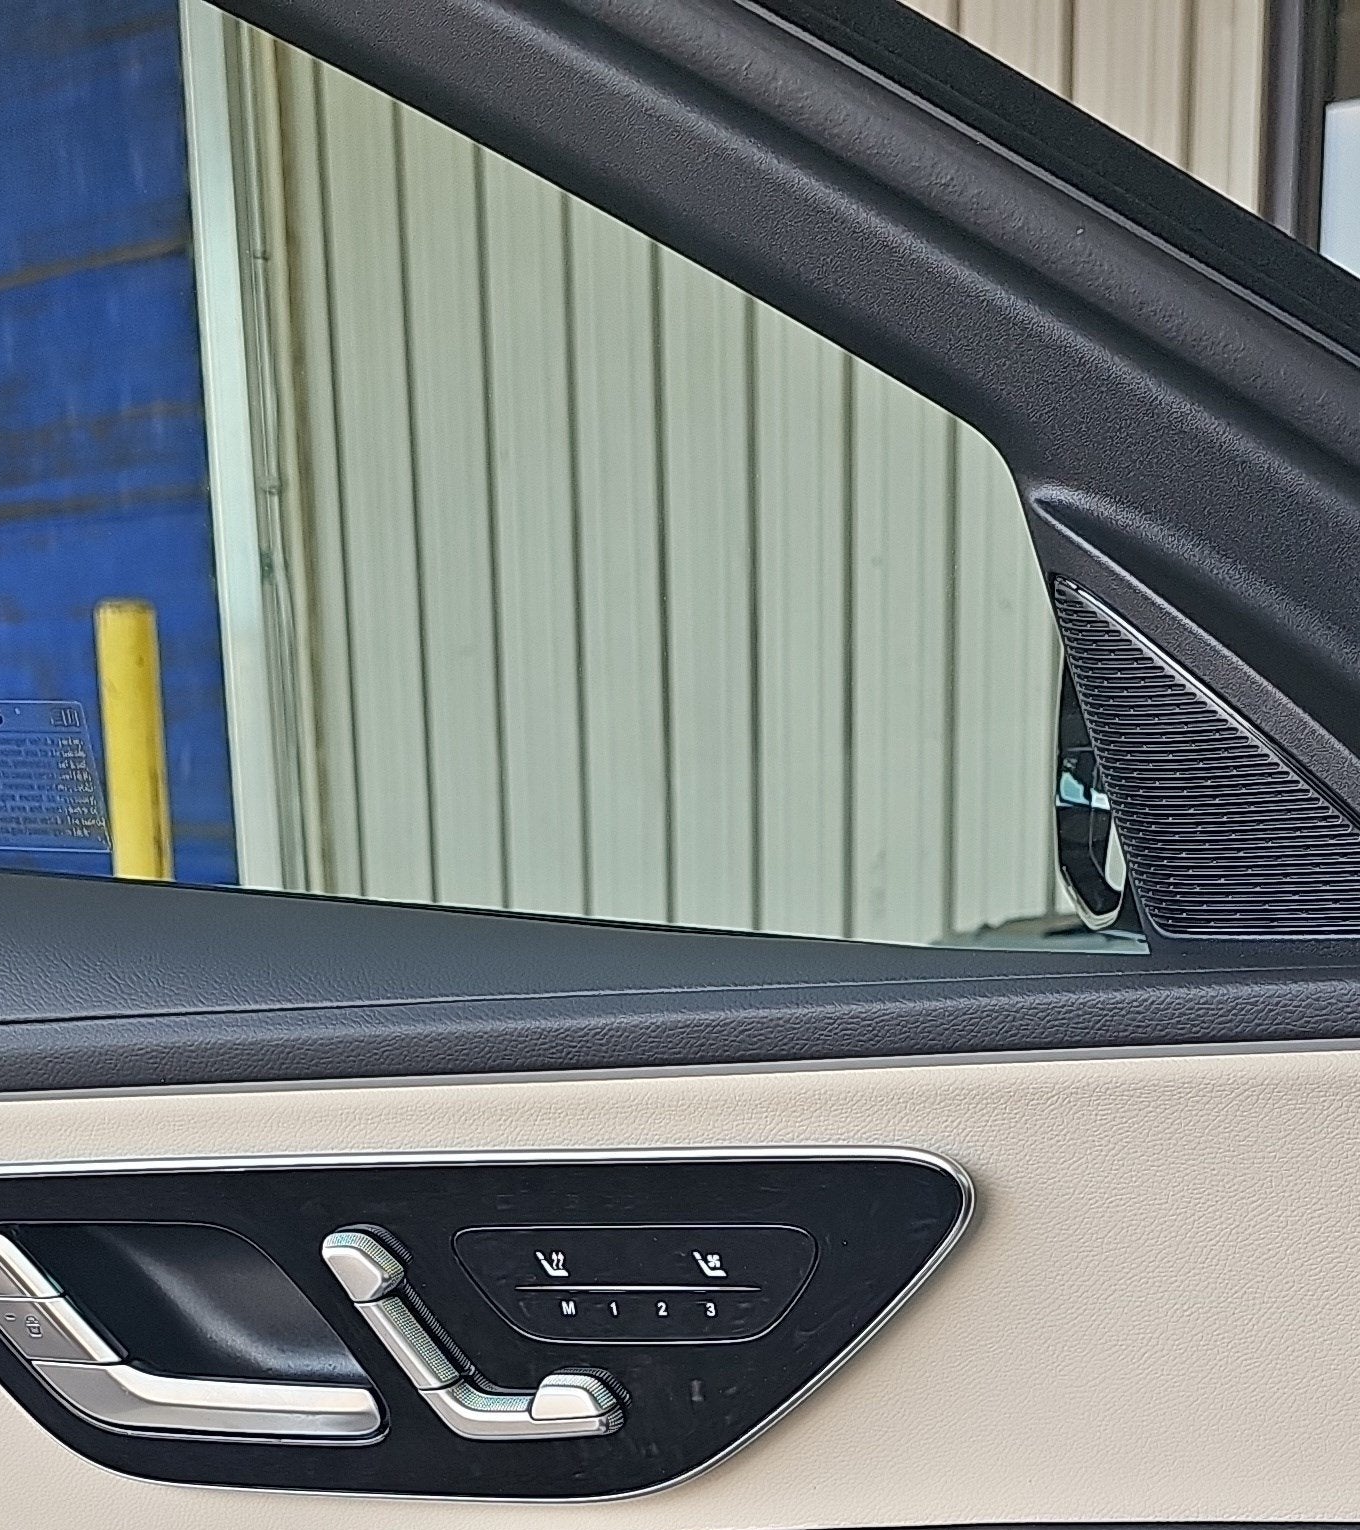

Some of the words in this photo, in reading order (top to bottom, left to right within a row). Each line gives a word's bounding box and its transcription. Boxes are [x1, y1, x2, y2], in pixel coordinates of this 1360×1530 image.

[561, 1300, 576, 1316] M
[610, 1301, 618, 1316] 1
[657, 1301, 668, 1316] 2
[706, 1302, 716, 1317] 3
